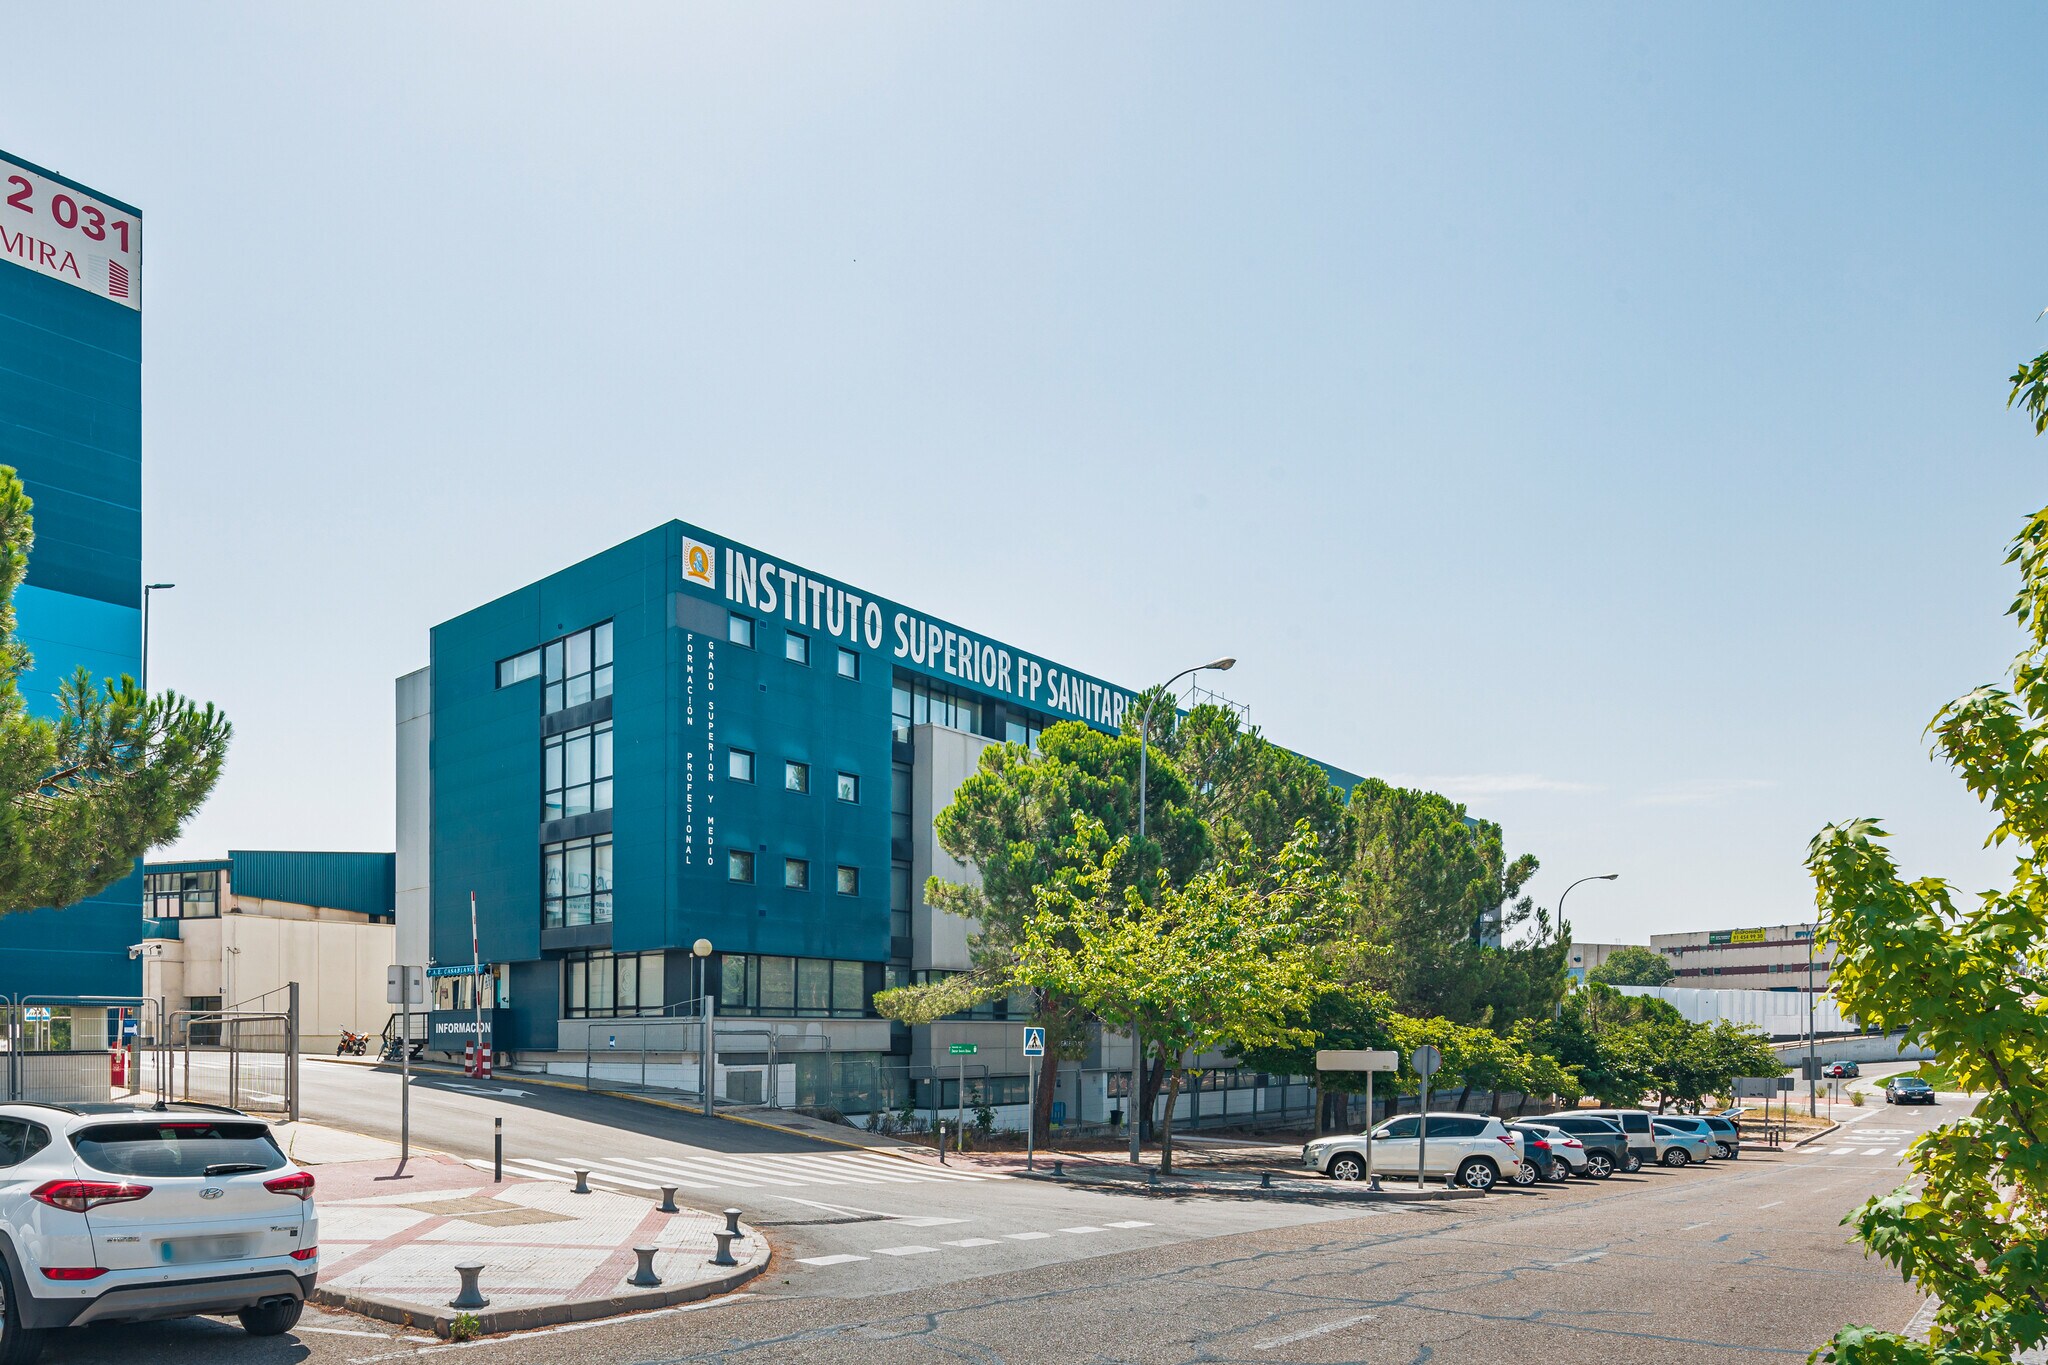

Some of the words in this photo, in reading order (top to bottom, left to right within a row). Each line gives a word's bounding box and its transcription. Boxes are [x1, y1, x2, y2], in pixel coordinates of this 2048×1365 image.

[6, 174, 34, 214] 2
[51, 193, 129, 254] 031
[725, 547, 883, 650] INSTITUTO
[894, 612, 1012, 694] SUPERIOR
[1018, 656, 1042, 702] FP
[686, 633, 694, 726] FORMACIÓN
[685, 752, 693, 865] PROFESIONAL
[707, 794, 714, 803] Y
